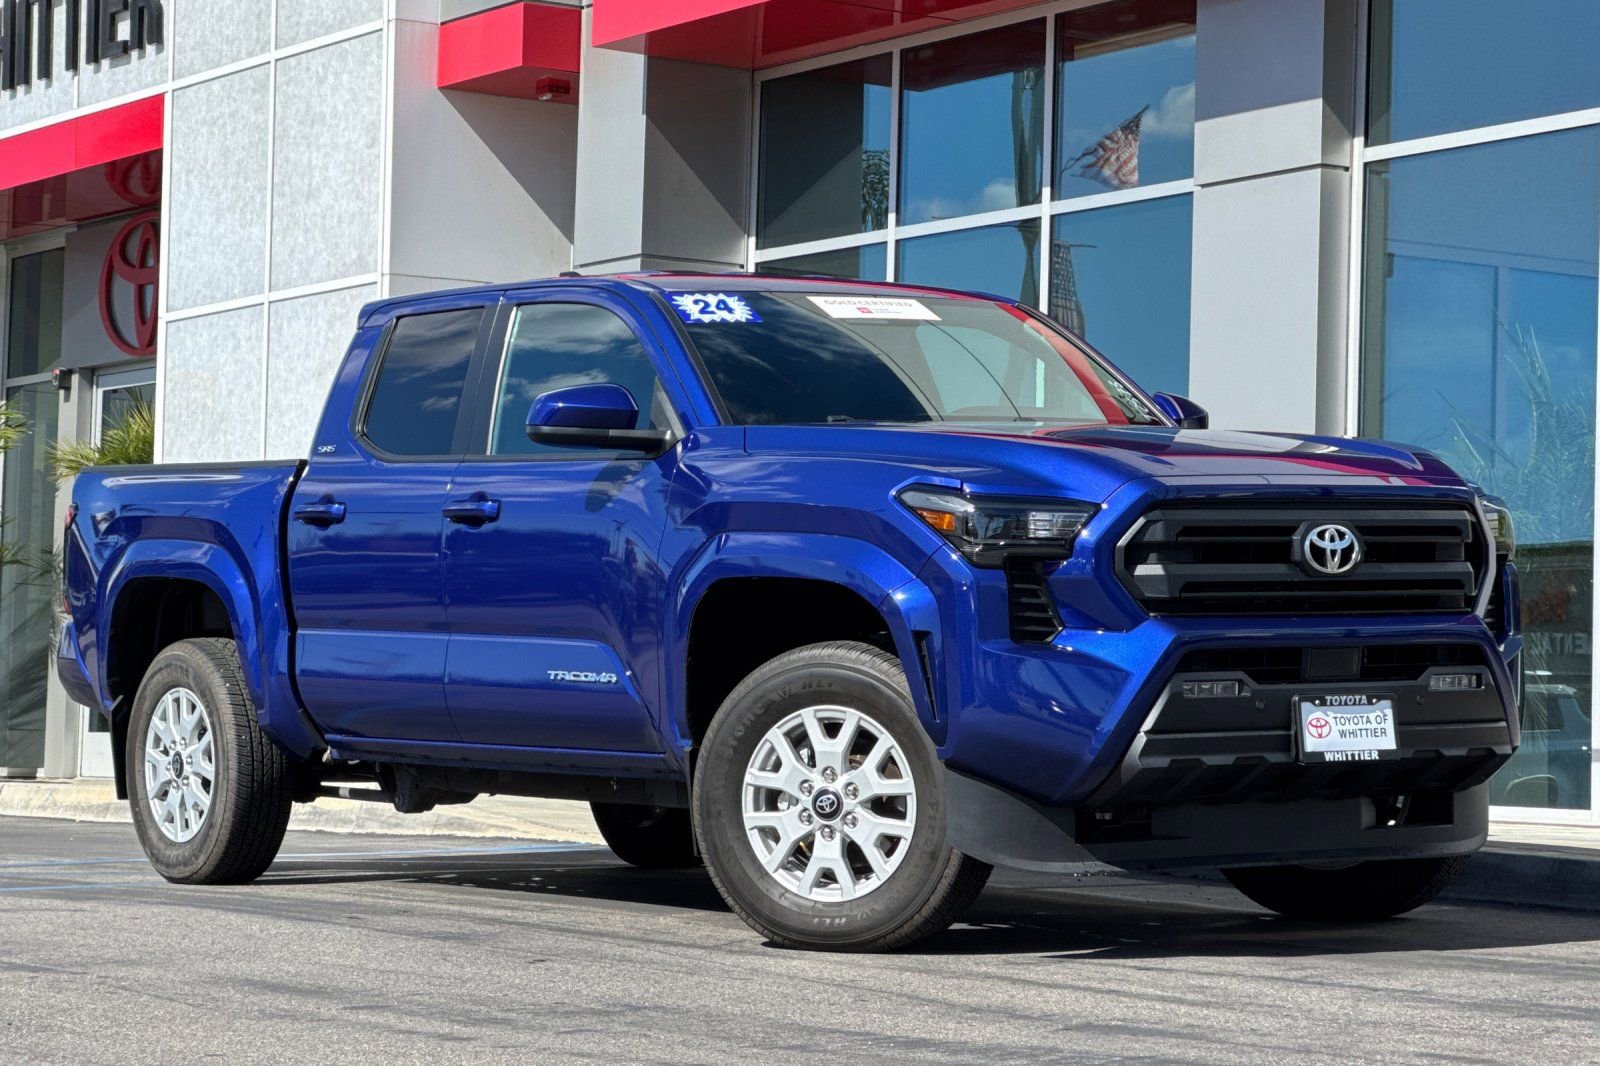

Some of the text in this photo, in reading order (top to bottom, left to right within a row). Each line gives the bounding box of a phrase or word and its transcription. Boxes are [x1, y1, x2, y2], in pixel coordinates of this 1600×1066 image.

[692, 299, 735, 315] 24
[547, 670, 617, 683] TACOMA
[1325, 695, 1368, 706] TOYOTA
[1332, 714, 1389, 727] TOYOTA OF
[1338, 728, 1387, 739] WHITTIER
[1324, 750, 1380, 762] WHITTIER
